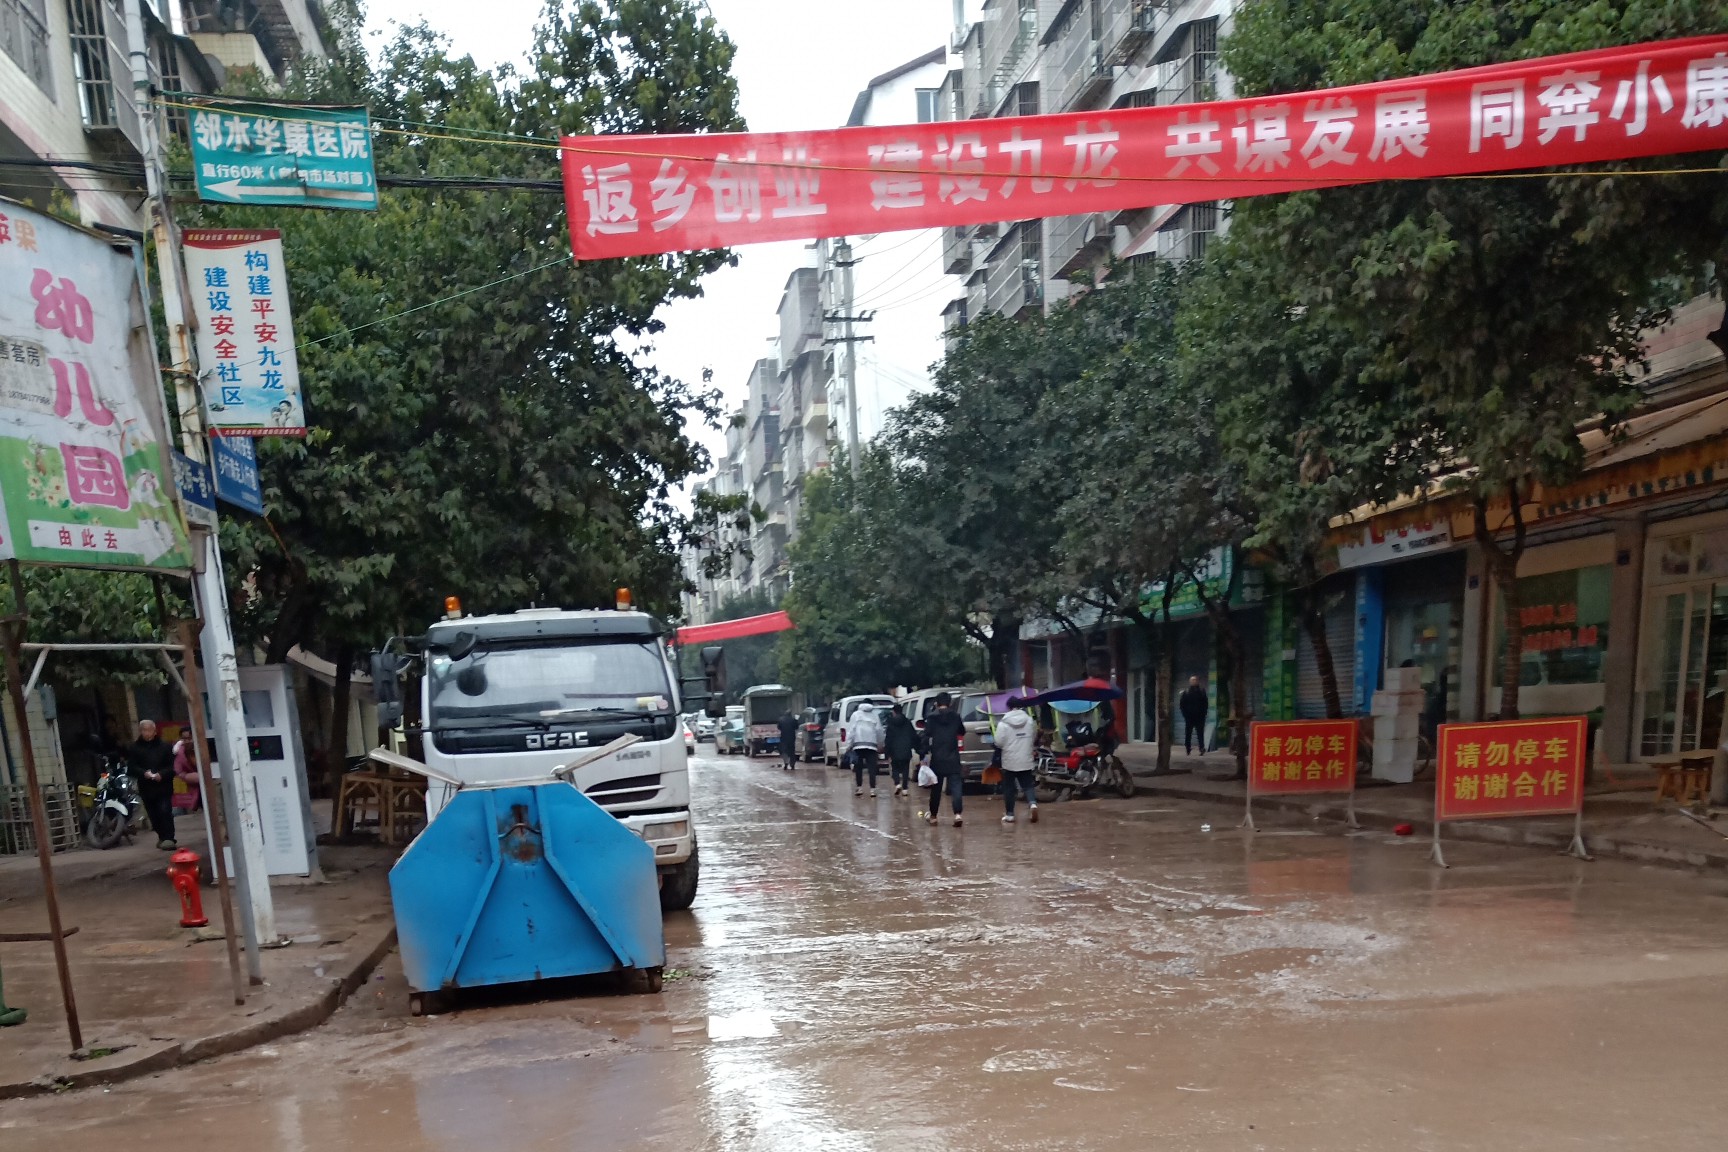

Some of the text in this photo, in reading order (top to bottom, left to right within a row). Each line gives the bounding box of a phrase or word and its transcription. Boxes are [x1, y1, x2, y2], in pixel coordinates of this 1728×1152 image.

[193, 110, 369, 159] 邻水华康医院
[581, 52, 1728, 237] 返乡创业 建设九龙 共谋发展 同奔小康
[203, 266, 244, 405] 建设安全社区
[244, 250, 284, 390] 构建平安九龙
[30, 268, 131, 509] 幼儿园
[58, 526, 118, 549] 由此去
[525, 731, 589, 749] DFAC
[1262, 734, 1346, 757] 请勿停车
[1455, 736, 1569, 769] 请勿停车
[1261, 759, 1346, 782] 谢谢合作
[1453, 769, 1569, 801] 谢谢合作
